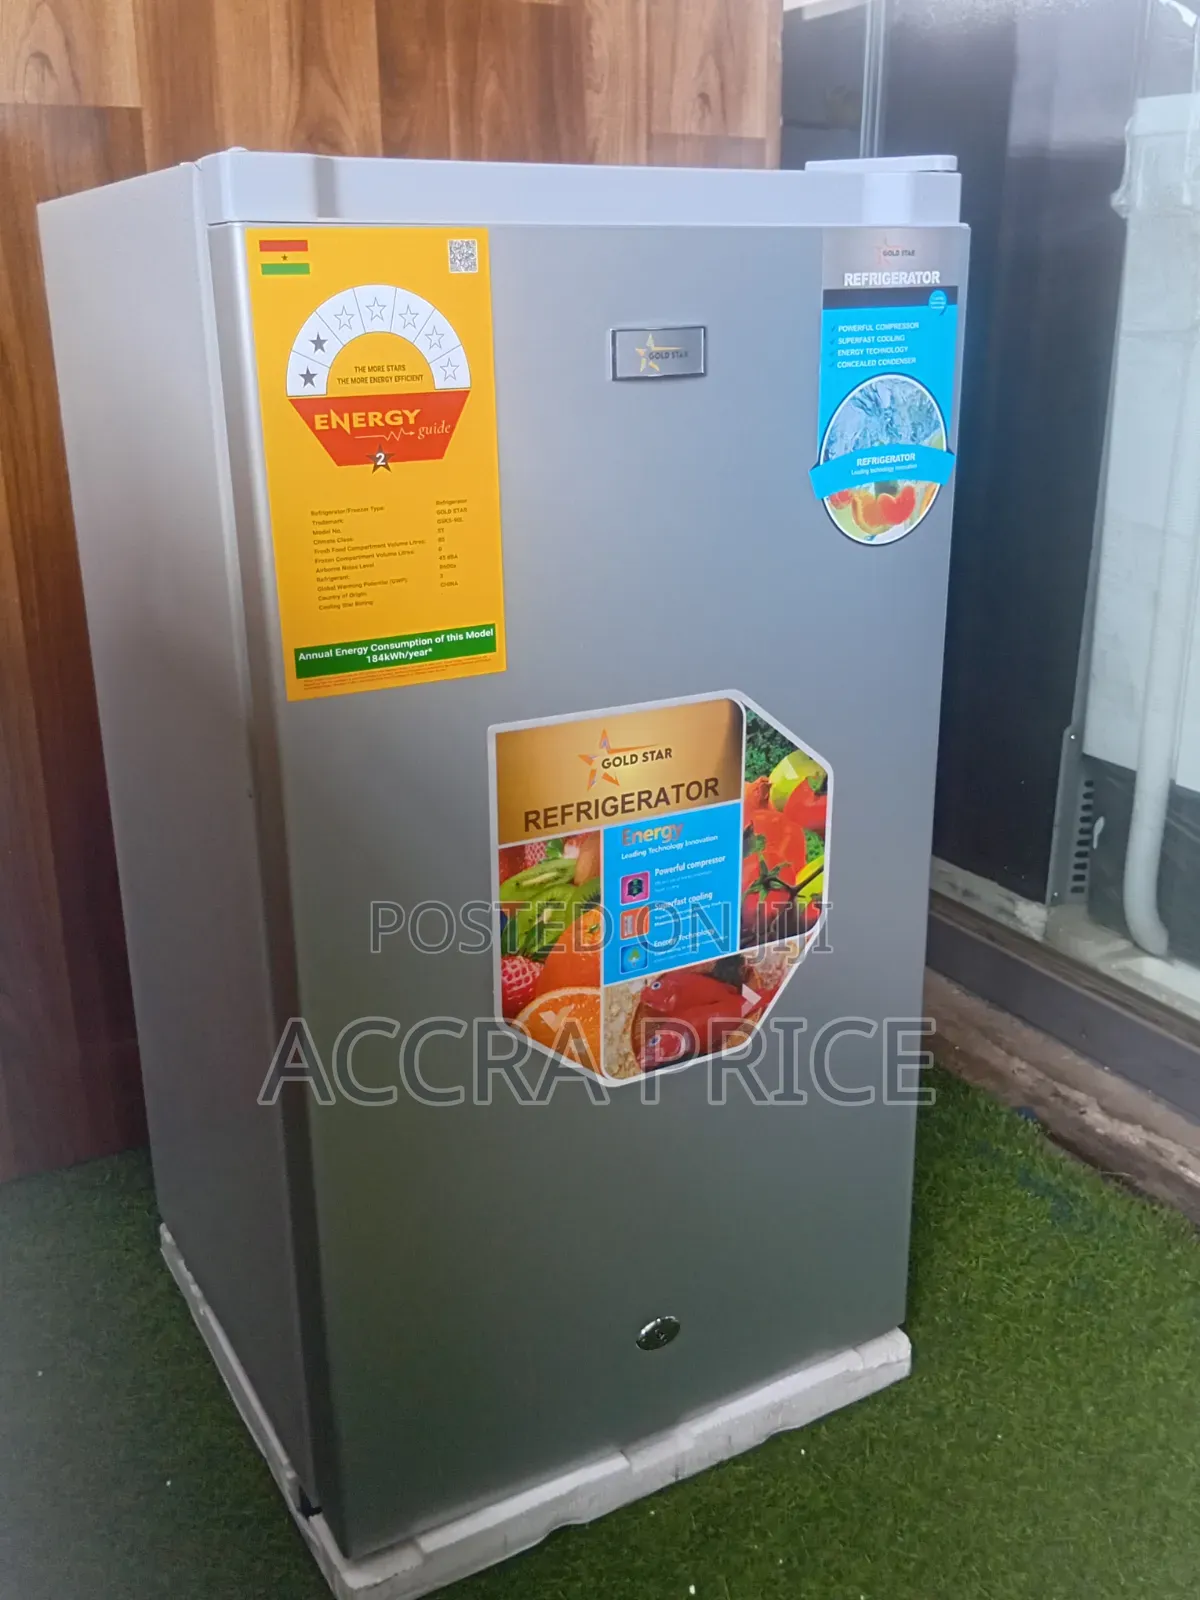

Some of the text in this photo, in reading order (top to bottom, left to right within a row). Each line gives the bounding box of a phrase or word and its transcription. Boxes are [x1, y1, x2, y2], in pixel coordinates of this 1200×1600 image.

[844, 271, 940, 286] REFRIGERATOR
[838, 322, 919, 332] POWERFUL COMPRESSOR
[838, 334, 905, 345] SUPERFAST COOLING
[648, 352, 670, 360] GOLD
[838, 346, 908, 356] ENERGY TECHNOLOGY
[386, 364, 406, 372] STARS
[837, 358, 916, 368] CONCEALED CONDENSER
[370, 376, 393, 384] ENERGY
[394, 374, 424, 382] EFFICIENT
[418, 420, 451, 440] guide
[375, 452, 386, 466] 2
[856, 453, 916, 466] REFRIGERATOR
[298, 628, 494, 662] Annual Energy Consumption of this Model
[601, 748, 673, 770] GOLD STAR
[524, 777, 720, 833] REFRIGERATOR
[622, 822, 684, 847] Energy
[621, 834, 718, 860] Leading Technology Innovation
[654, 855, 726, 876] Powerful compressor
[654, 891, 713, 911] Superfast cooling
[654, 928, 715, 948] Energy Technology
